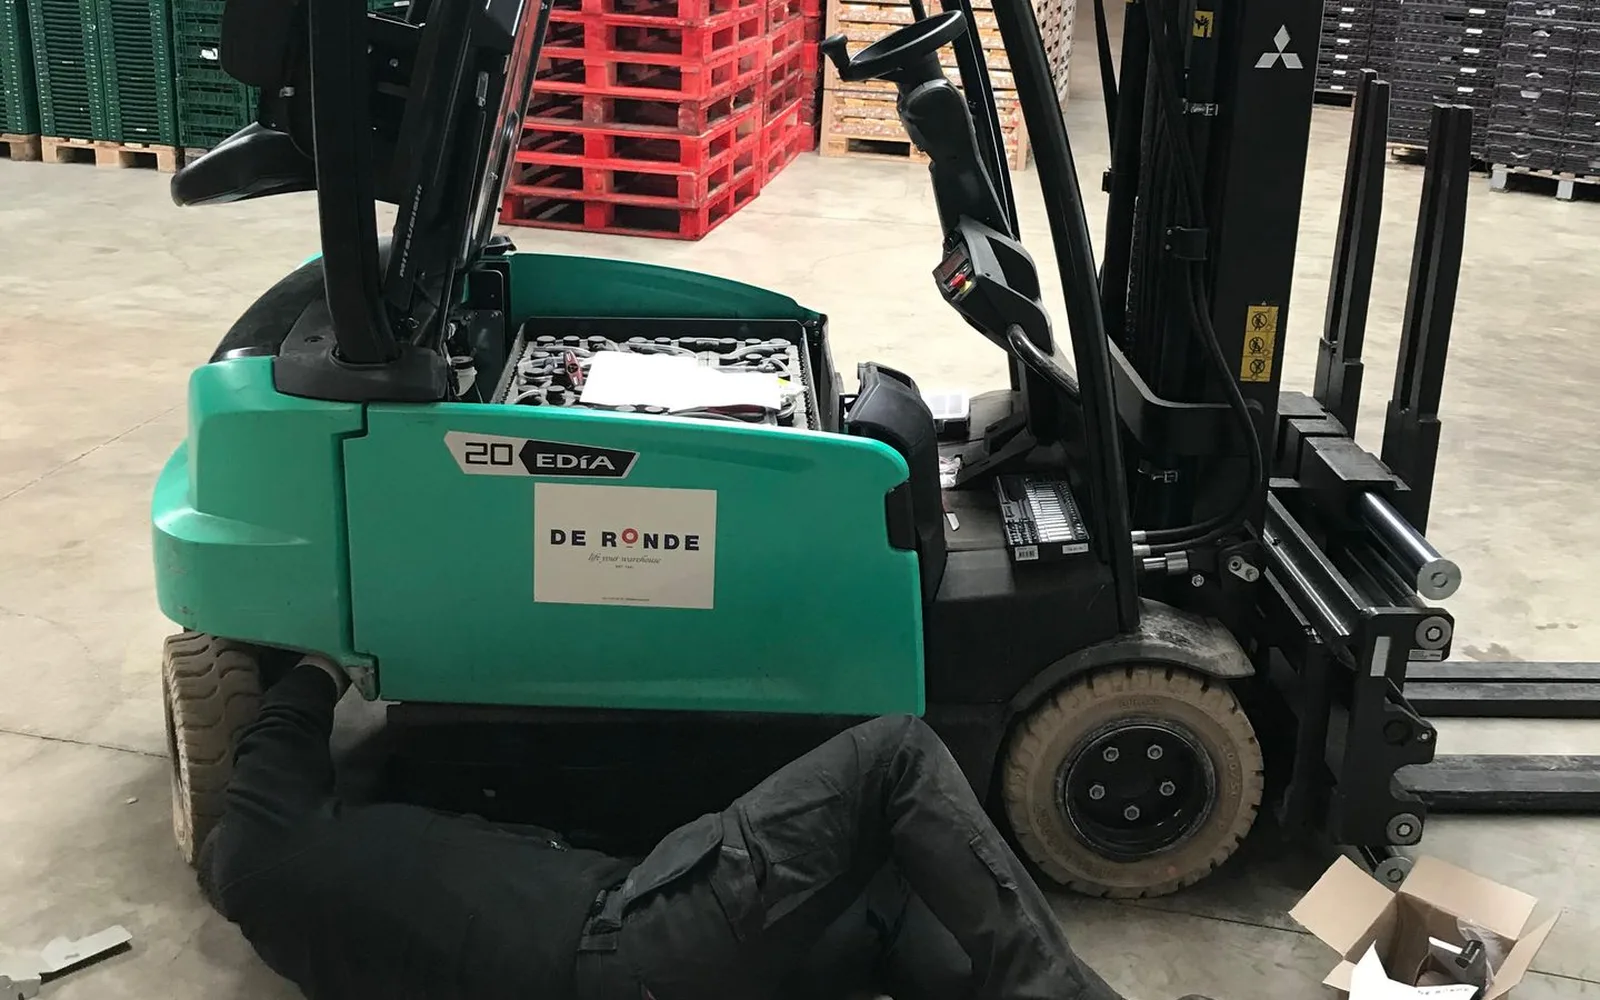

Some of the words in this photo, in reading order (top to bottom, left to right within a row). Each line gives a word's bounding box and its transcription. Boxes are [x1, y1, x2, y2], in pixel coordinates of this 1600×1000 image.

[465, 442, 513, 466] 20
[551, 529, 586, 546] DE
[601, 528, 700, 550] RONDE
[621, 554, 662, 565] warehouse
